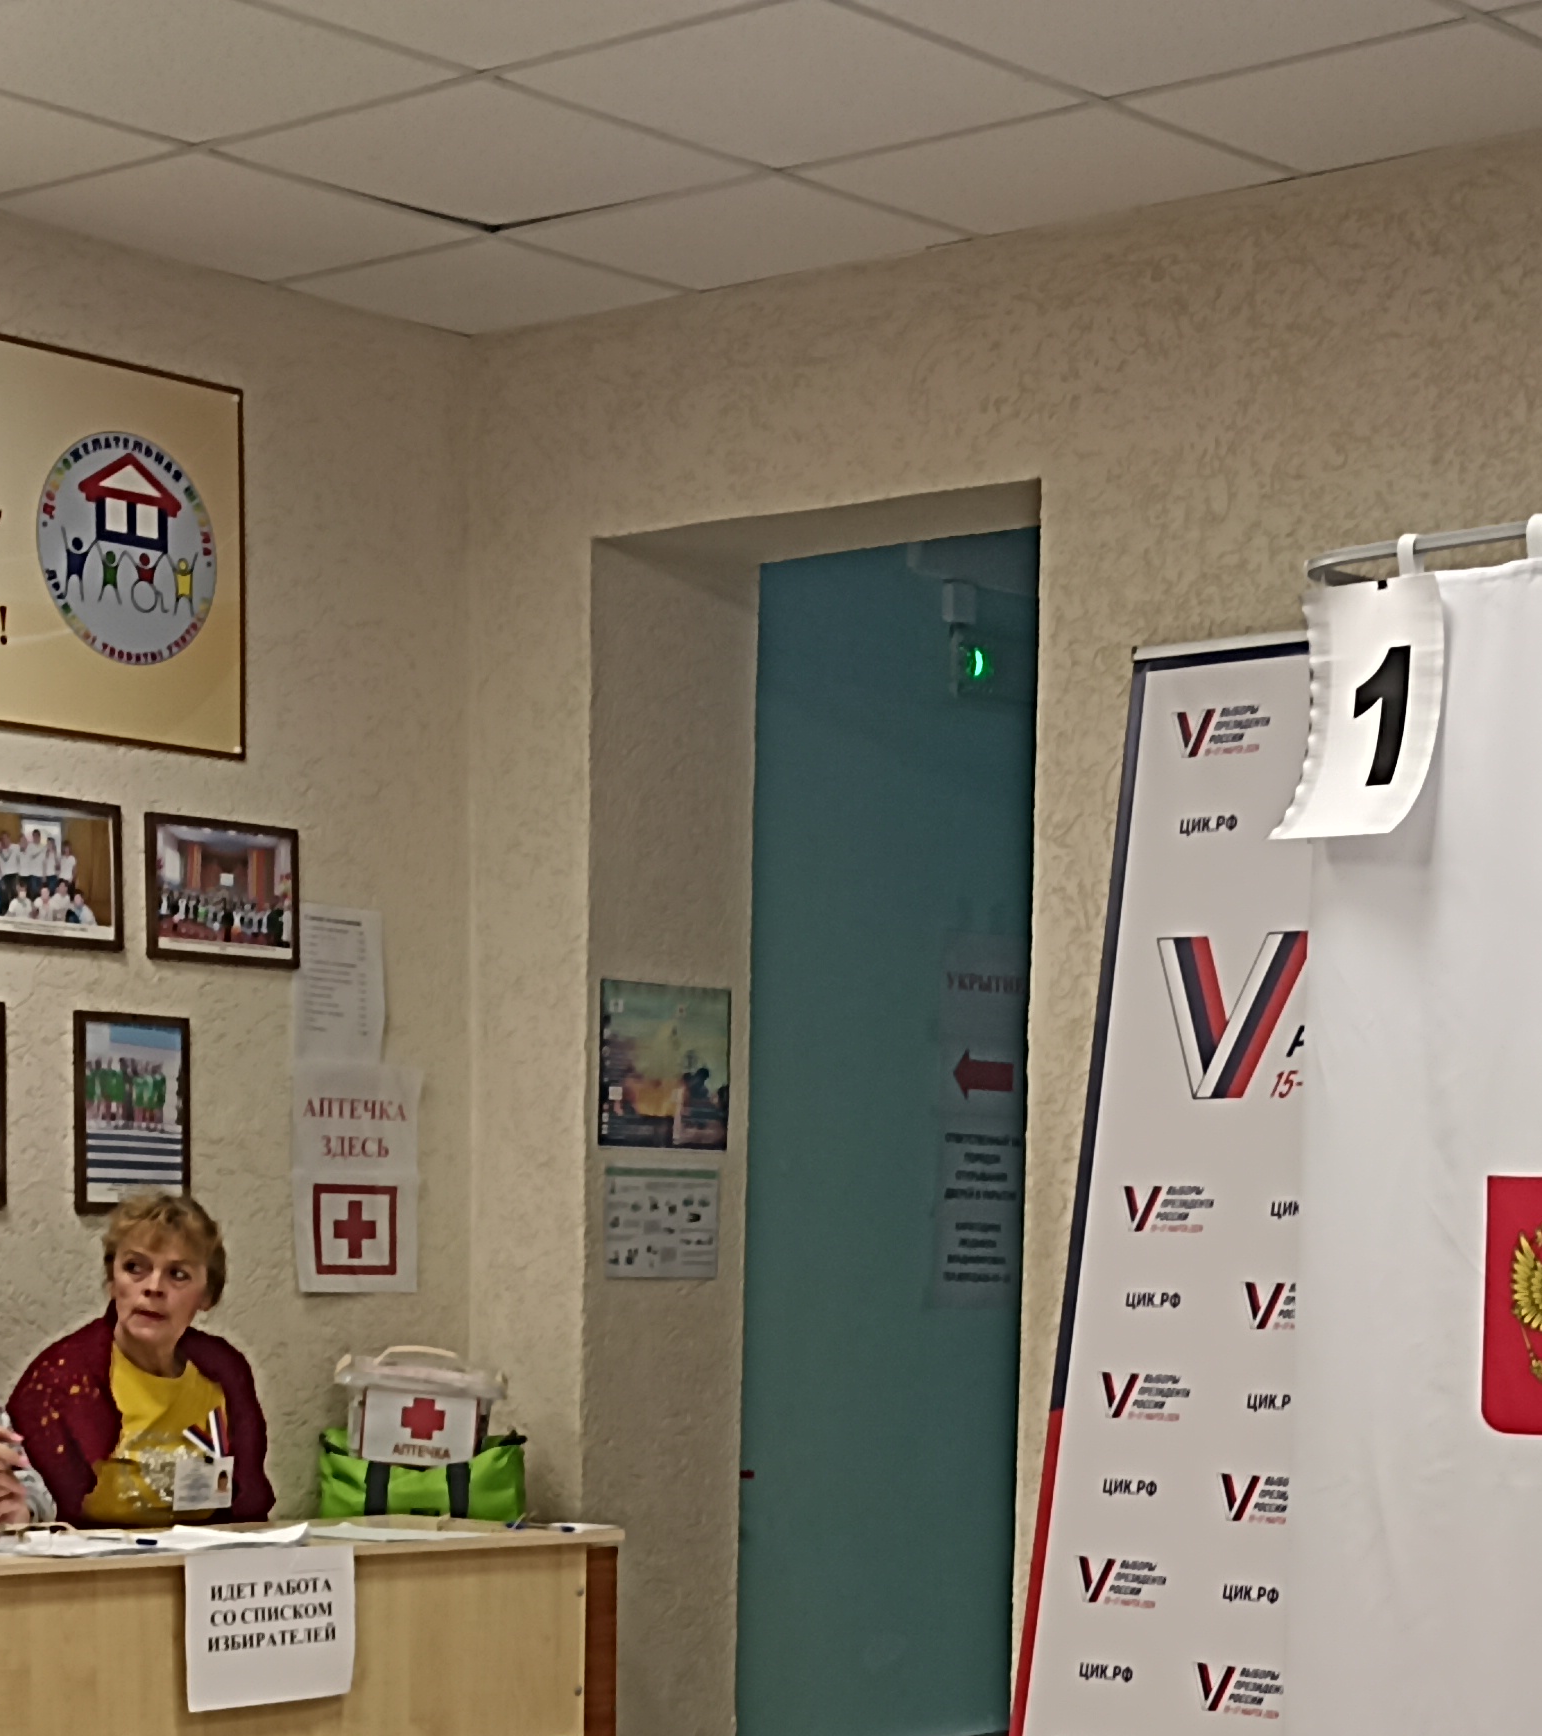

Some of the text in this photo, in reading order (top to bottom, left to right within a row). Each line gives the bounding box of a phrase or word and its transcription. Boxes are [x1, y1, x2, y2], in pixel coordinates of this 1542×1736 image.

[1353, 645, 1411, 786] 1
[1179, 814, 1238, 836] ЦИК.РФ
[303, 1097, 407, 1122] АПТЕЧКА
[321, 1135, 390, 1161] ЗДЕСЬ
[1125, 1291, 1182, 1310] ЦИК.РФ
[1102, 1477, 1158, 1497] ЦИК.РФ
[211, 1577, 332, 1602] ИДЕТ РАБОТА
[1222, 1583, 1280, 1605] ЦИК.РФ
[210, 1601, 332, 1627] СО СПИСКОМ
[208, 1622, 336, 1652] ИЗБИРАТЕЛЕЙ
[1079, 1661, 1134, 1683] ЦИК.РФ
